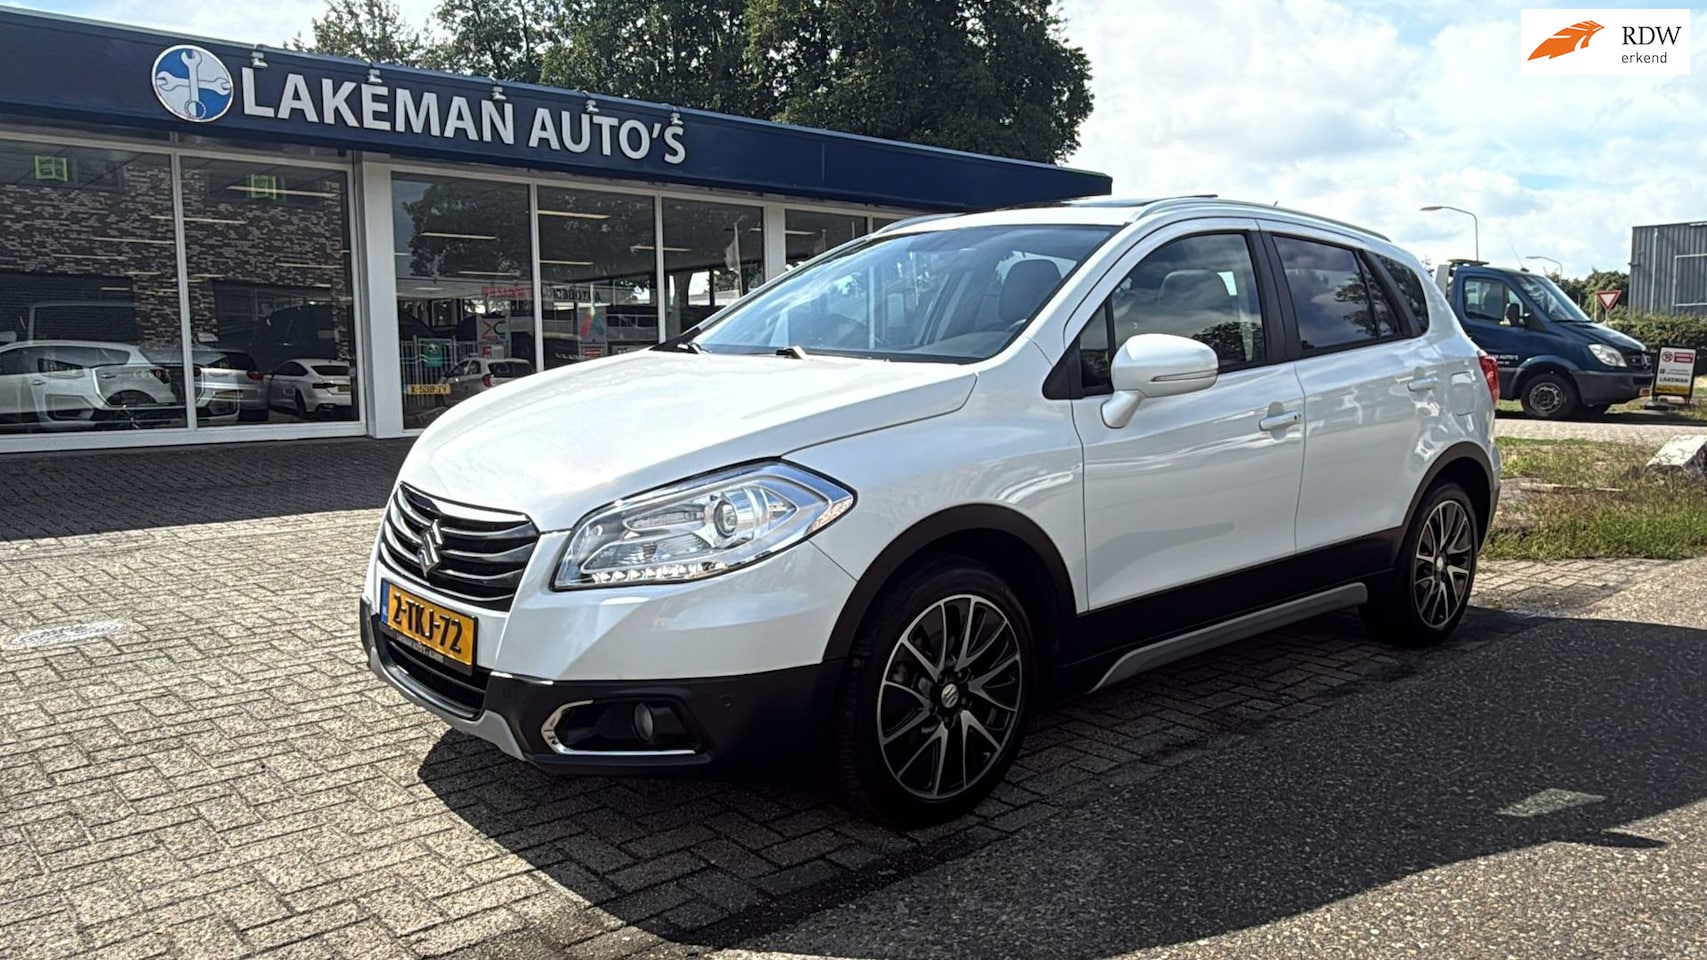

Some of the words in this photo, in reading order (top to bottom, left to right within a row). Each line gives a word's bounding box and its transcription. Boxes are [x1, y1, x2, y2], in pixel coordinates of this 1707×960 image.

[241, 67, 515, 145] LAKEMAN
[528, 107, 687, 165] AUTO'S
[393, 592, 462, 654] 2-TKJ-72
